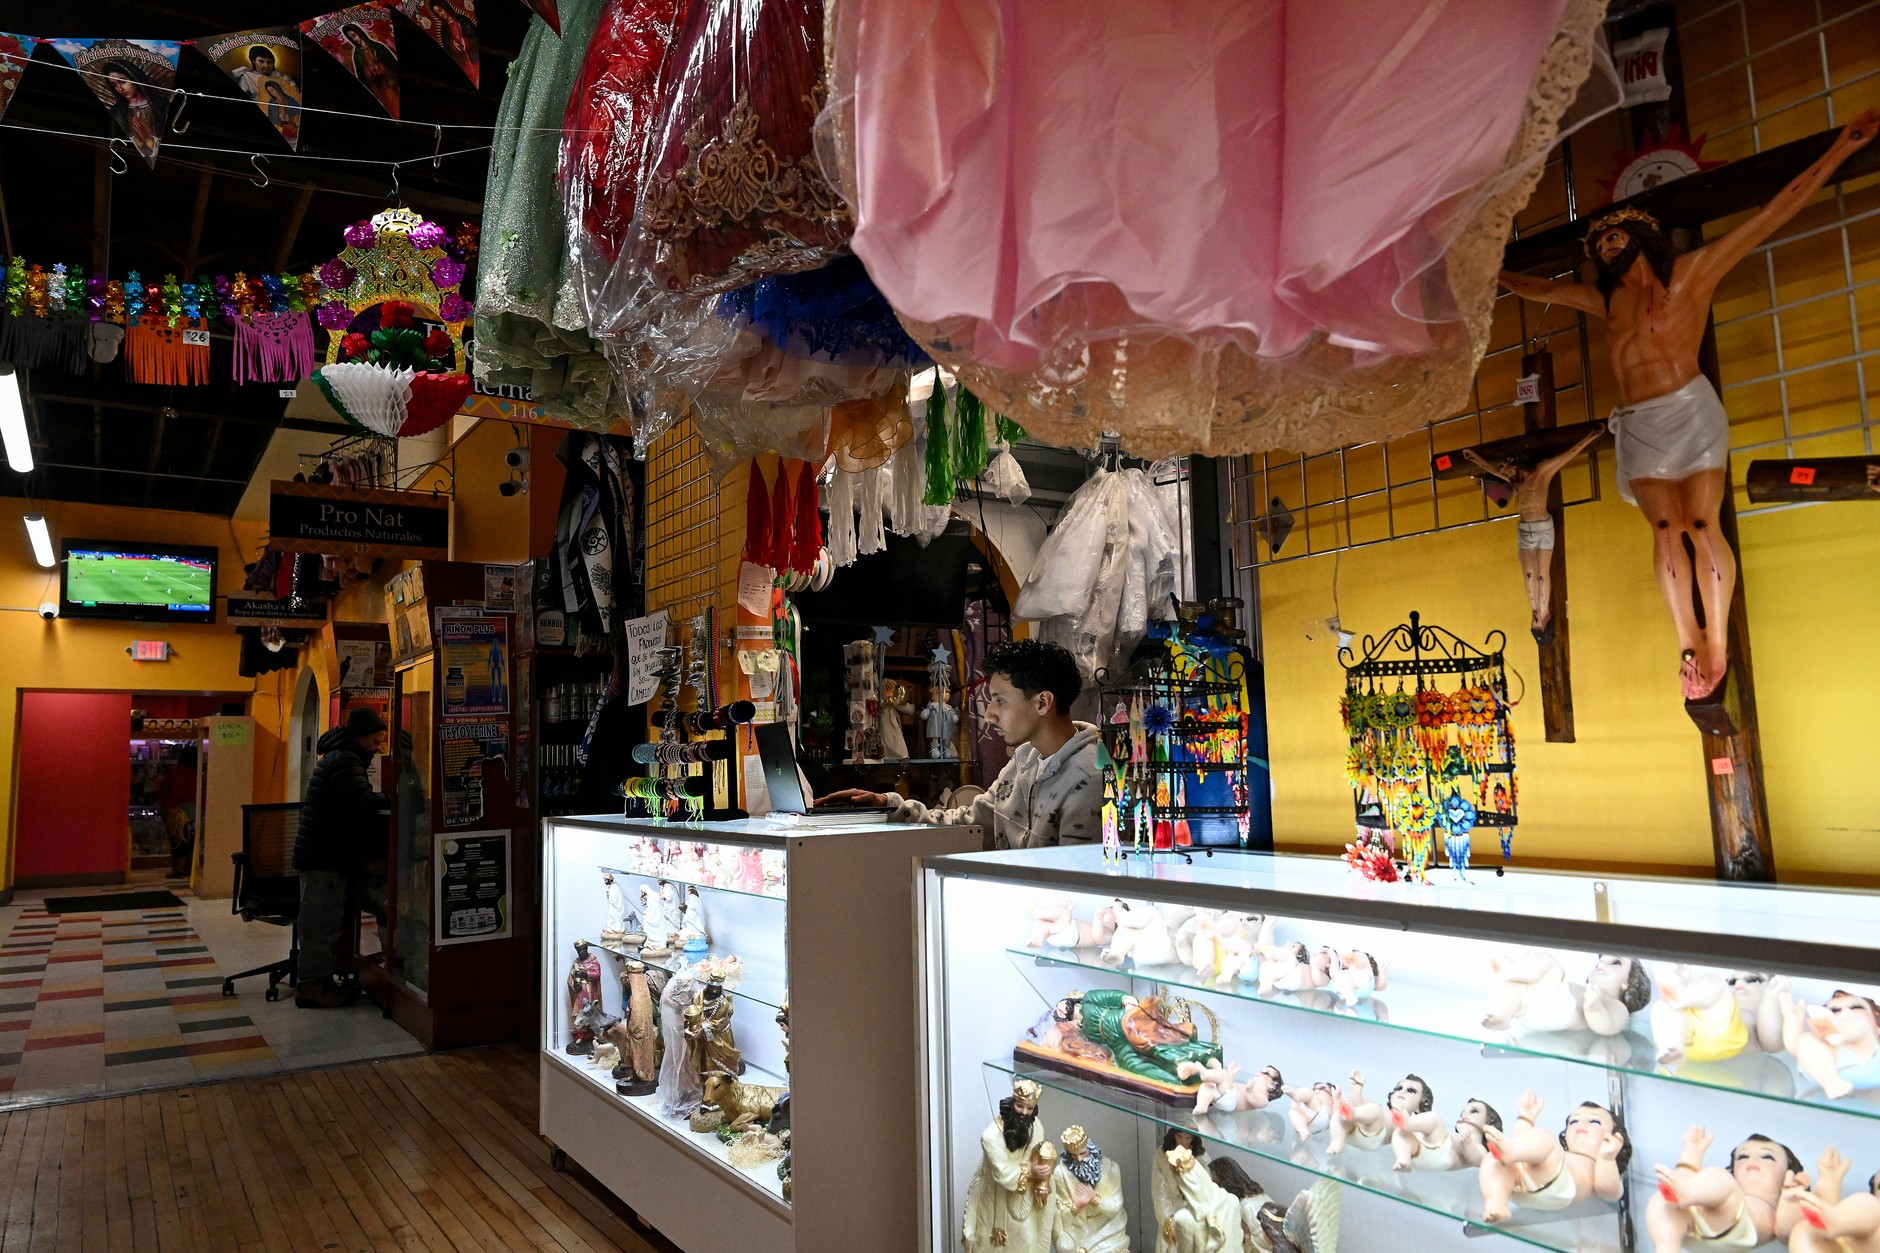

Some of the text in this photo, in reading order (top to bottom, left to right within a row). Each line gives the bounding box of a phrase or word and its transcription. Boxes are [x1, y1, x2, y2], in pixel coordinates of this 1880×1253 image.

[208, 32, 300, 62] Felicidades virgencita
[73, 43, 175, 70] Felicidades virgencita
[190, 331, 206, 343] 26
[474, 378, 532, 400] terna
[511, 404, 538, 420] 116
[319, 503, 405, 528] Pro Nat
[299, 523, 422, 543] Productos Naturales
[243, 601, 286, 611] Akasha's
[474, 625, 496, 634] PLUS
[627, 620, 663, 638] TODOS LOS
[138, 641, 164, 659] EXIT
